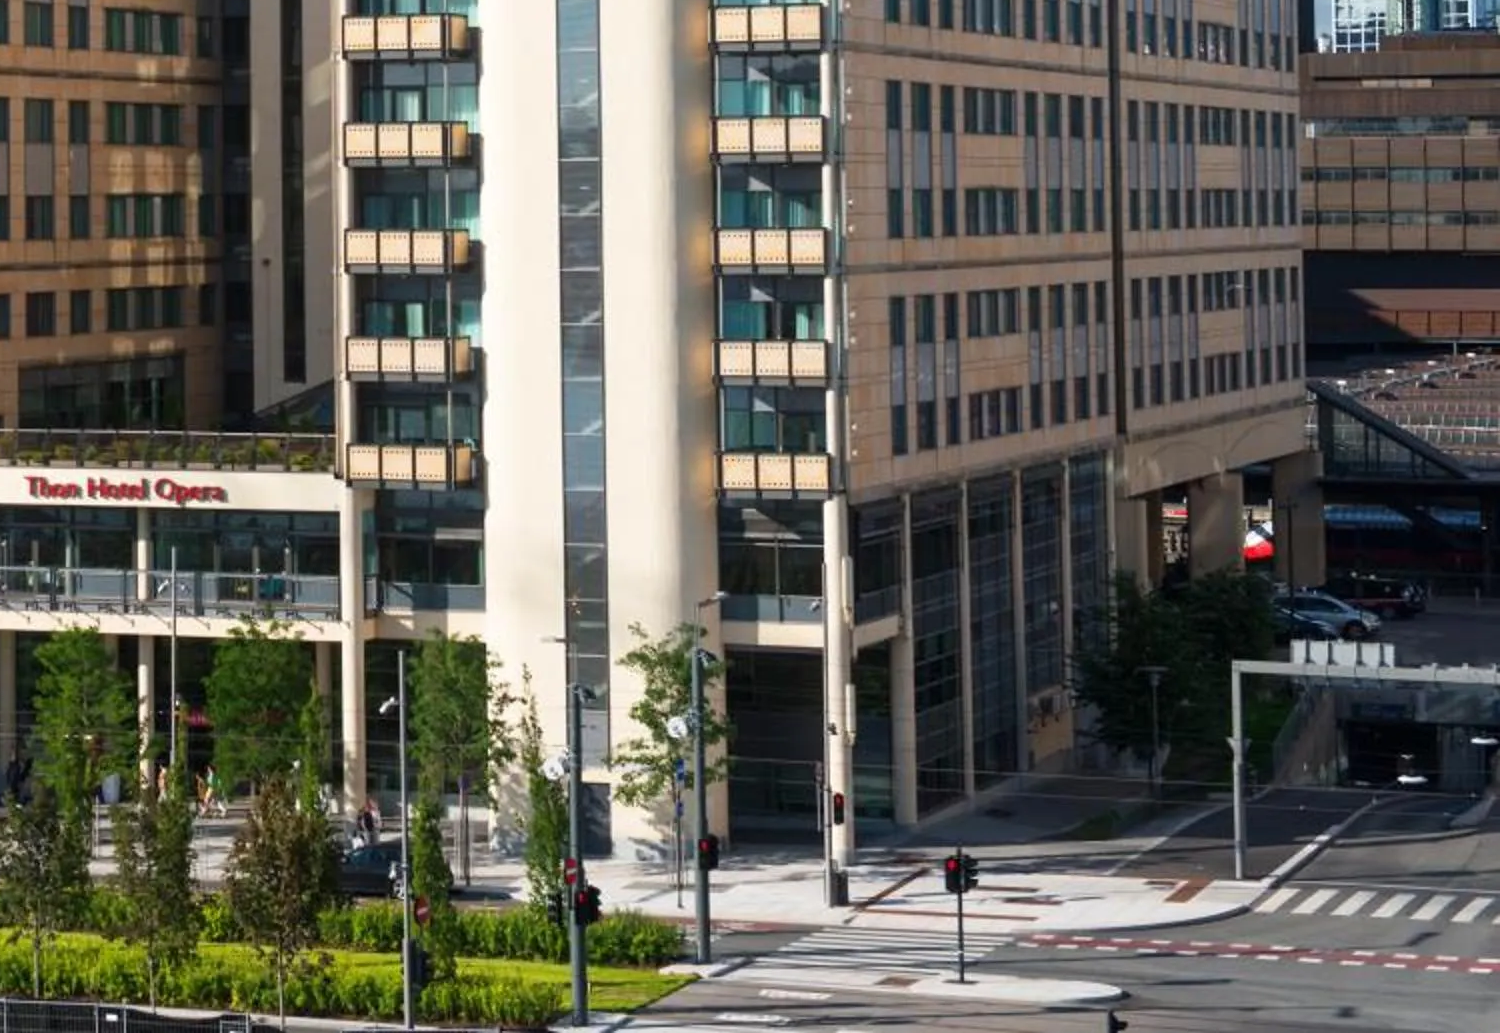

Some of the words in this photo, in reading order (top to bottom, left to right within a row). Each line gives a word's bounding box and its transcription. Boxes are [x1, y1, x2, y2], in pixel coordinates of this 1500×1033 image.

[24, 475, 82, 499] Thon
[87, 477, 149, 501] Hotel
[154, 478, 228, 506] Opera
